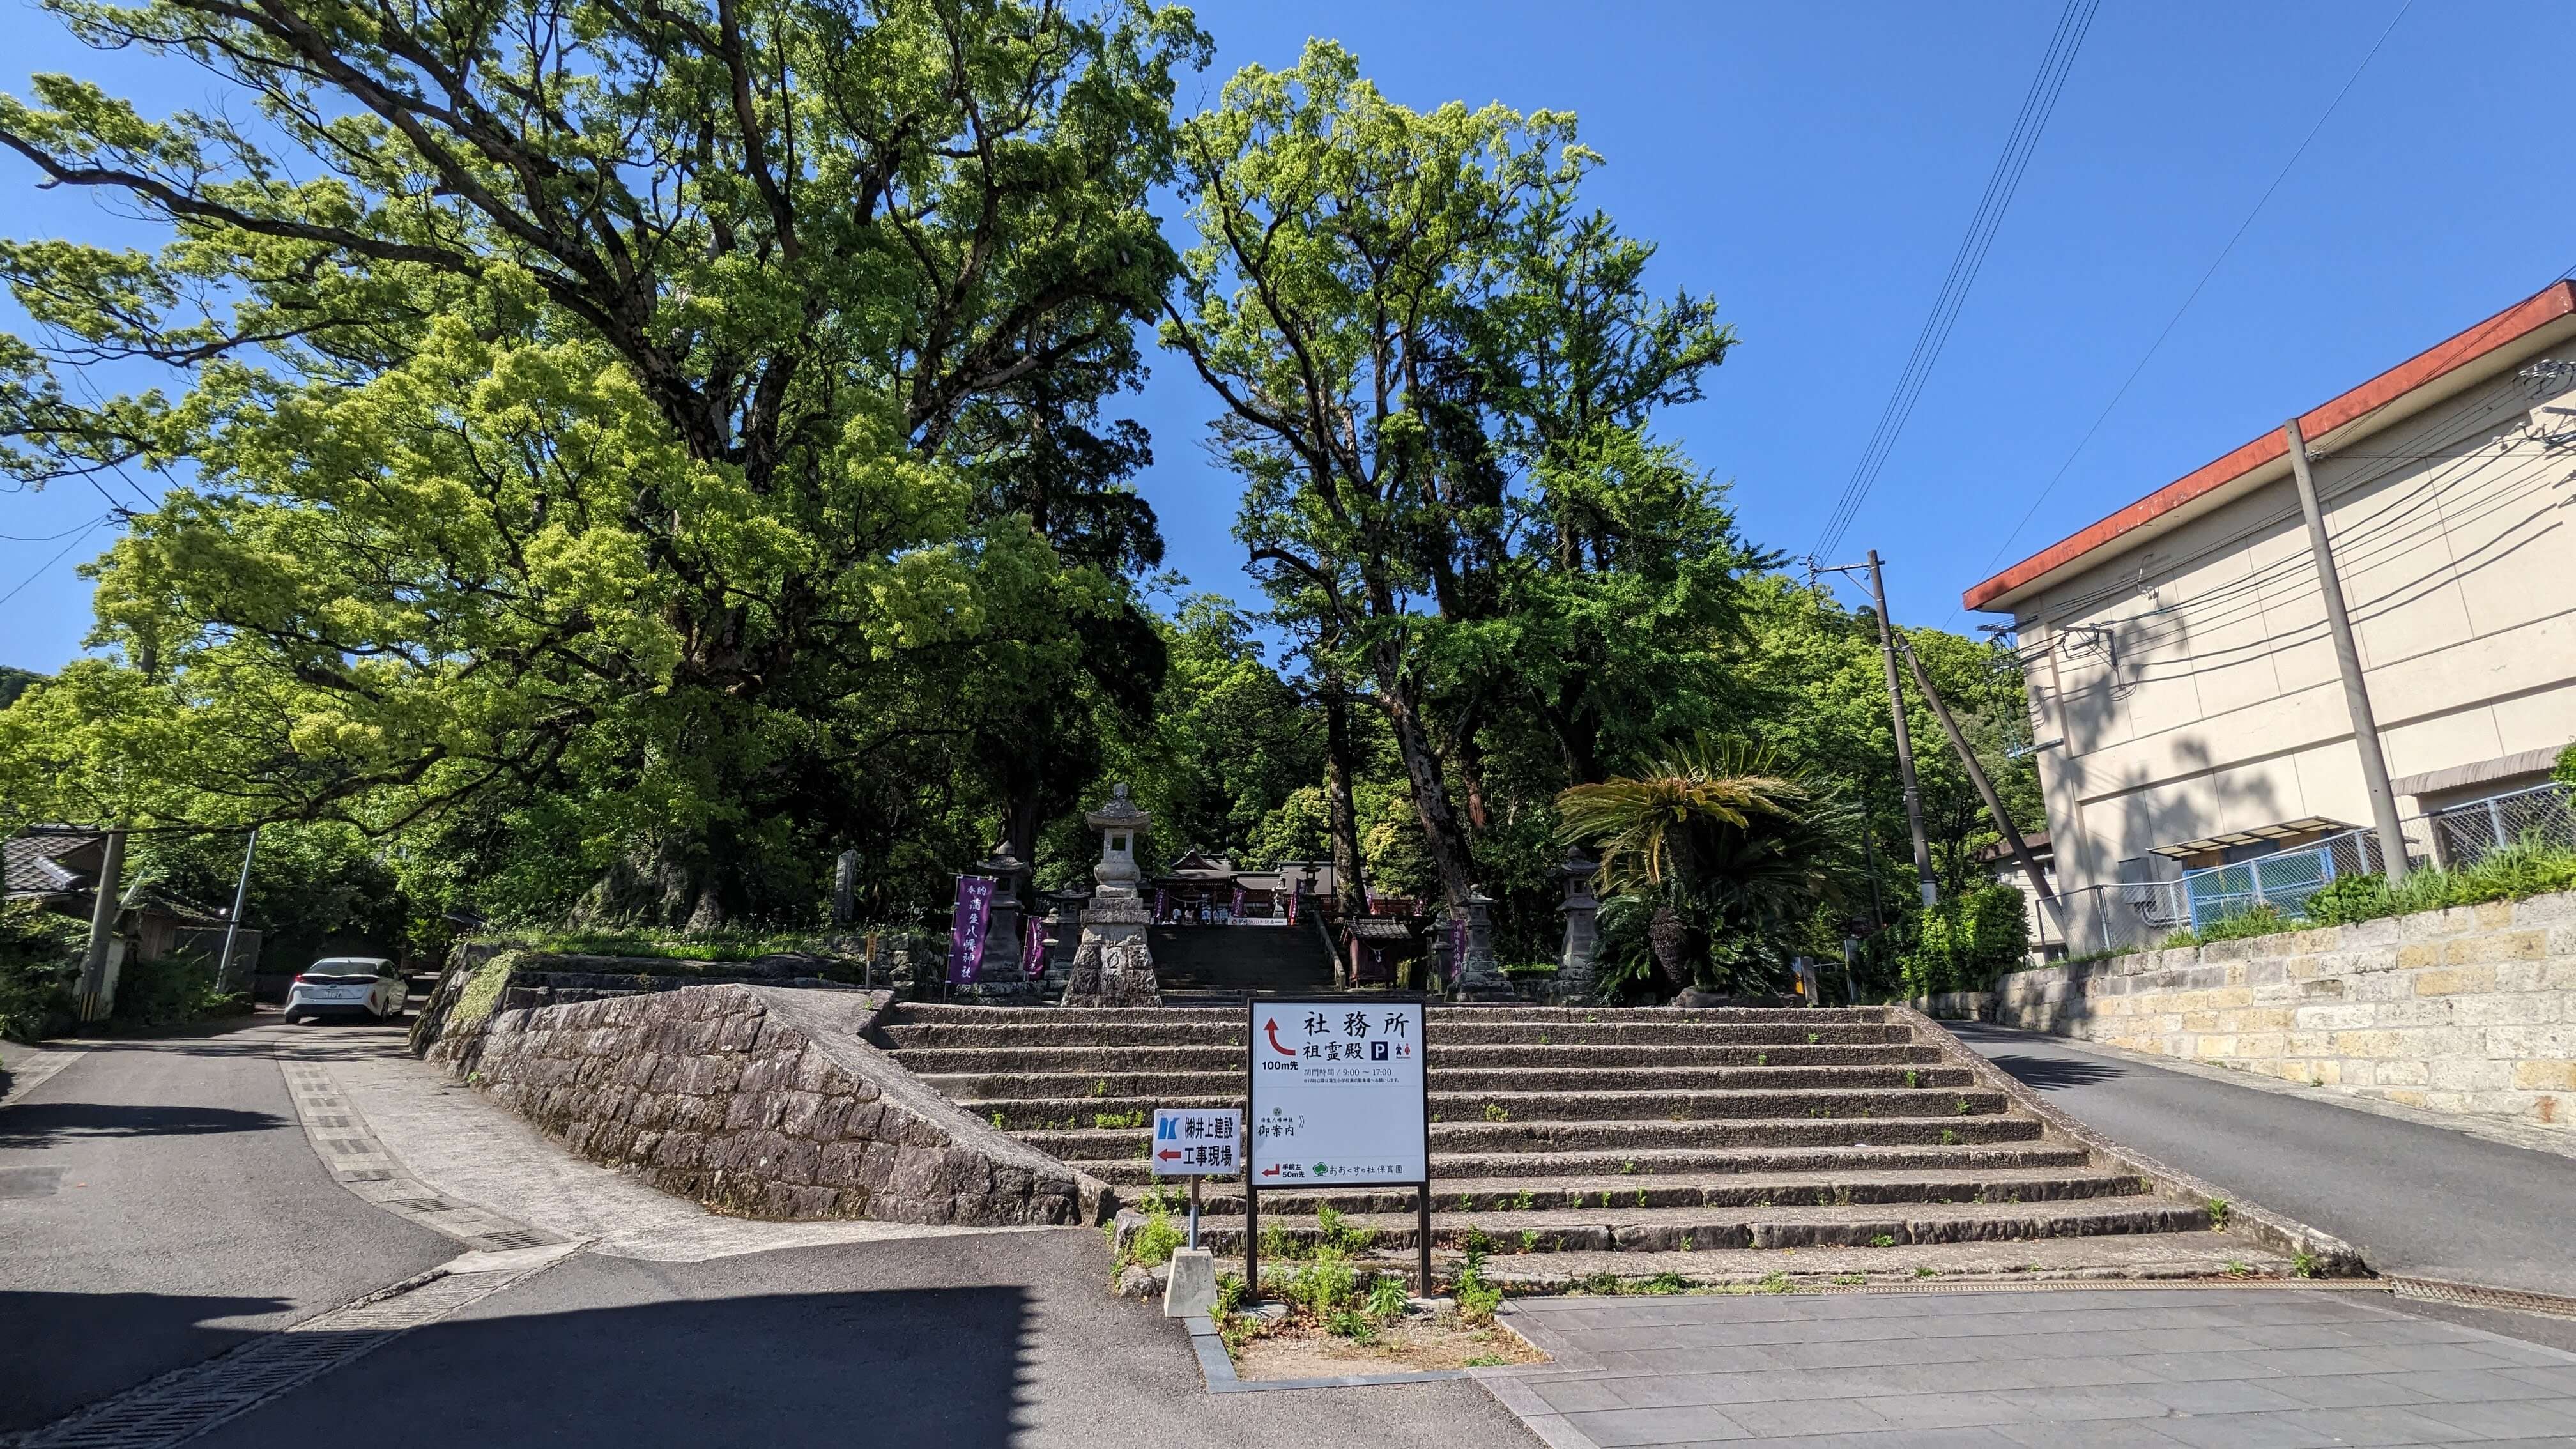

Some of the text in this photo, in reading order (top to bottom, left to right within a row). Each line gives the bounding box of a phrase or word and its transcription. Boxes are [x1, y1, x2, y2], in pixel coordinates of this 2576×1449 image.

[1303, 1011, 1410, 1039] 社務所
[1303, 1041, 1365, 1061] 祖霊殿
[1262, 1061, 1299, 1070] 100m先
[1304, 1068, 1335, 1077] 開門時間
[1257, 1124, 1294, 1137] 御案内
[1183, 1145, 1232, 1167] 工事現場
